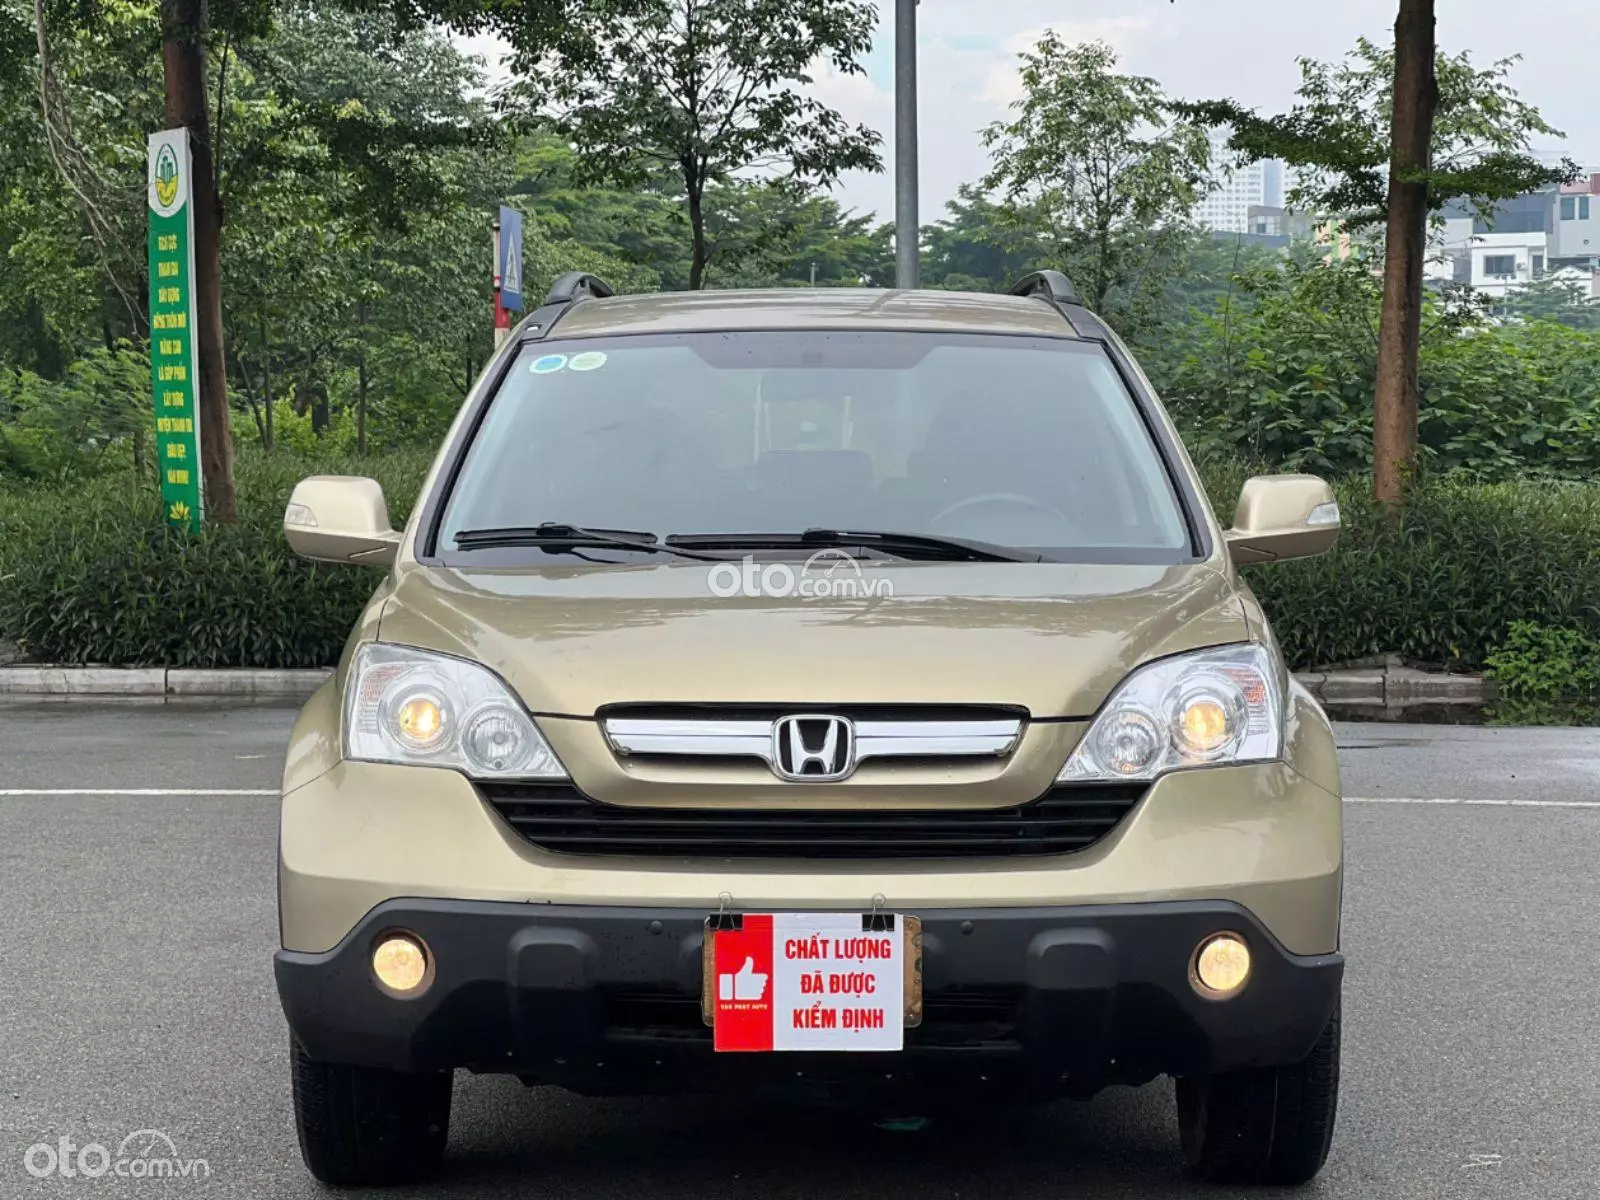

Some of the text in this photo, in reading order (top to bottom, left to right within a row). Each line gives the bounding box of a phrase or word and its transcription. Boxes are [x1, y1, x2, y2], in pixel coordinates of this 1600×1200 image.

[785, 932, 891, 964] CHẤT LƯỢNG
[800, 970, 876, 998] ĐÃ ĐƯỢC
[793, 1001, 884, 1033] KIỂM ĐỊNH
